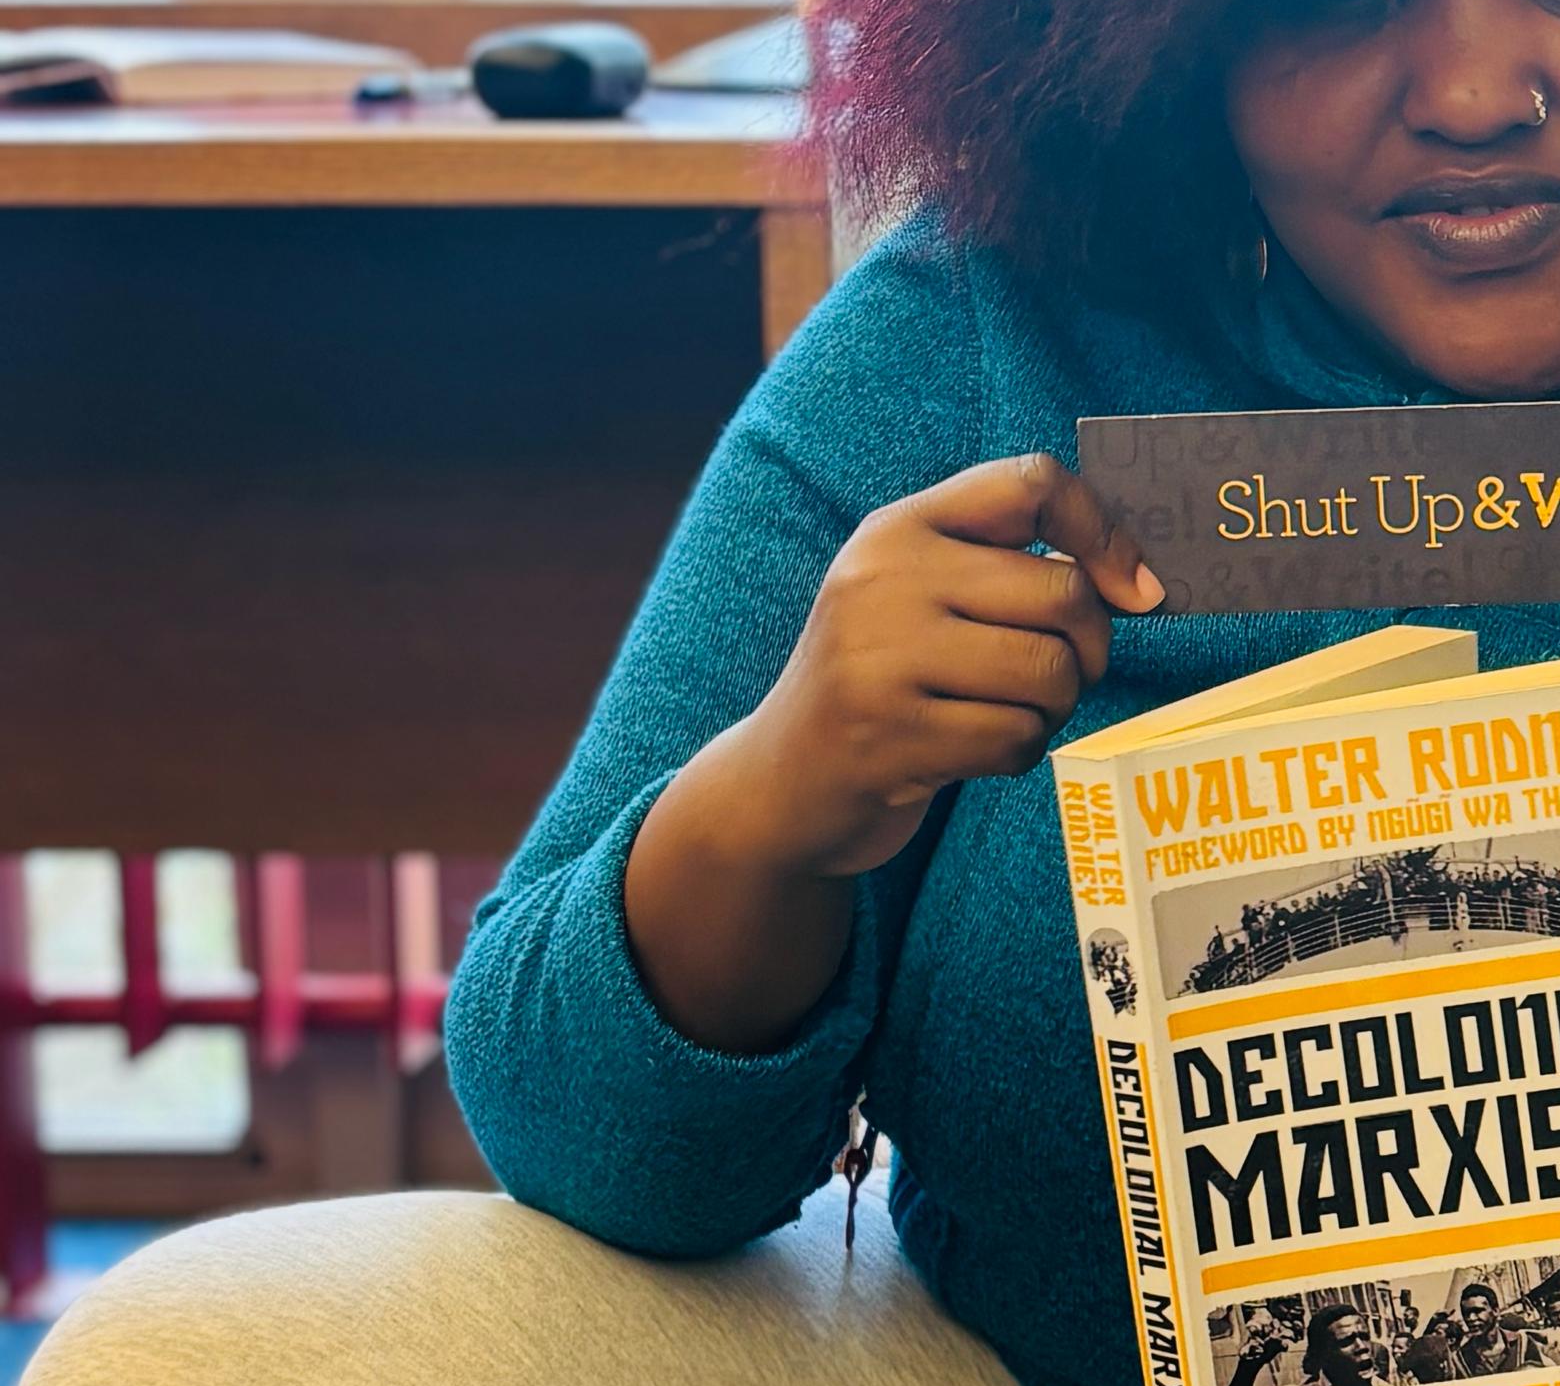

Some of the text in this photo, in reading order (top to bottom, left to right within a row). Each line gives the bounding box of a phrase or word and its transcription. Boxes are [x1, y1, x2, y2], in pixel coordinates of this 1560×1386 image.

[1216, 473, 1359, 541] Shut
[1061, 780, 1101, 907] RODNEY
[1133, 735, 1386, 838] WALTER
[1145, 821, 1309, 882] FOREWORD
[1319, 817, 1357, 861] BY
[1466, 791, 1513, 825] WA
[1087, 782, 1128, 907] WALTER
[1107, 1039, 1168, 1276] DECOLONIAL
